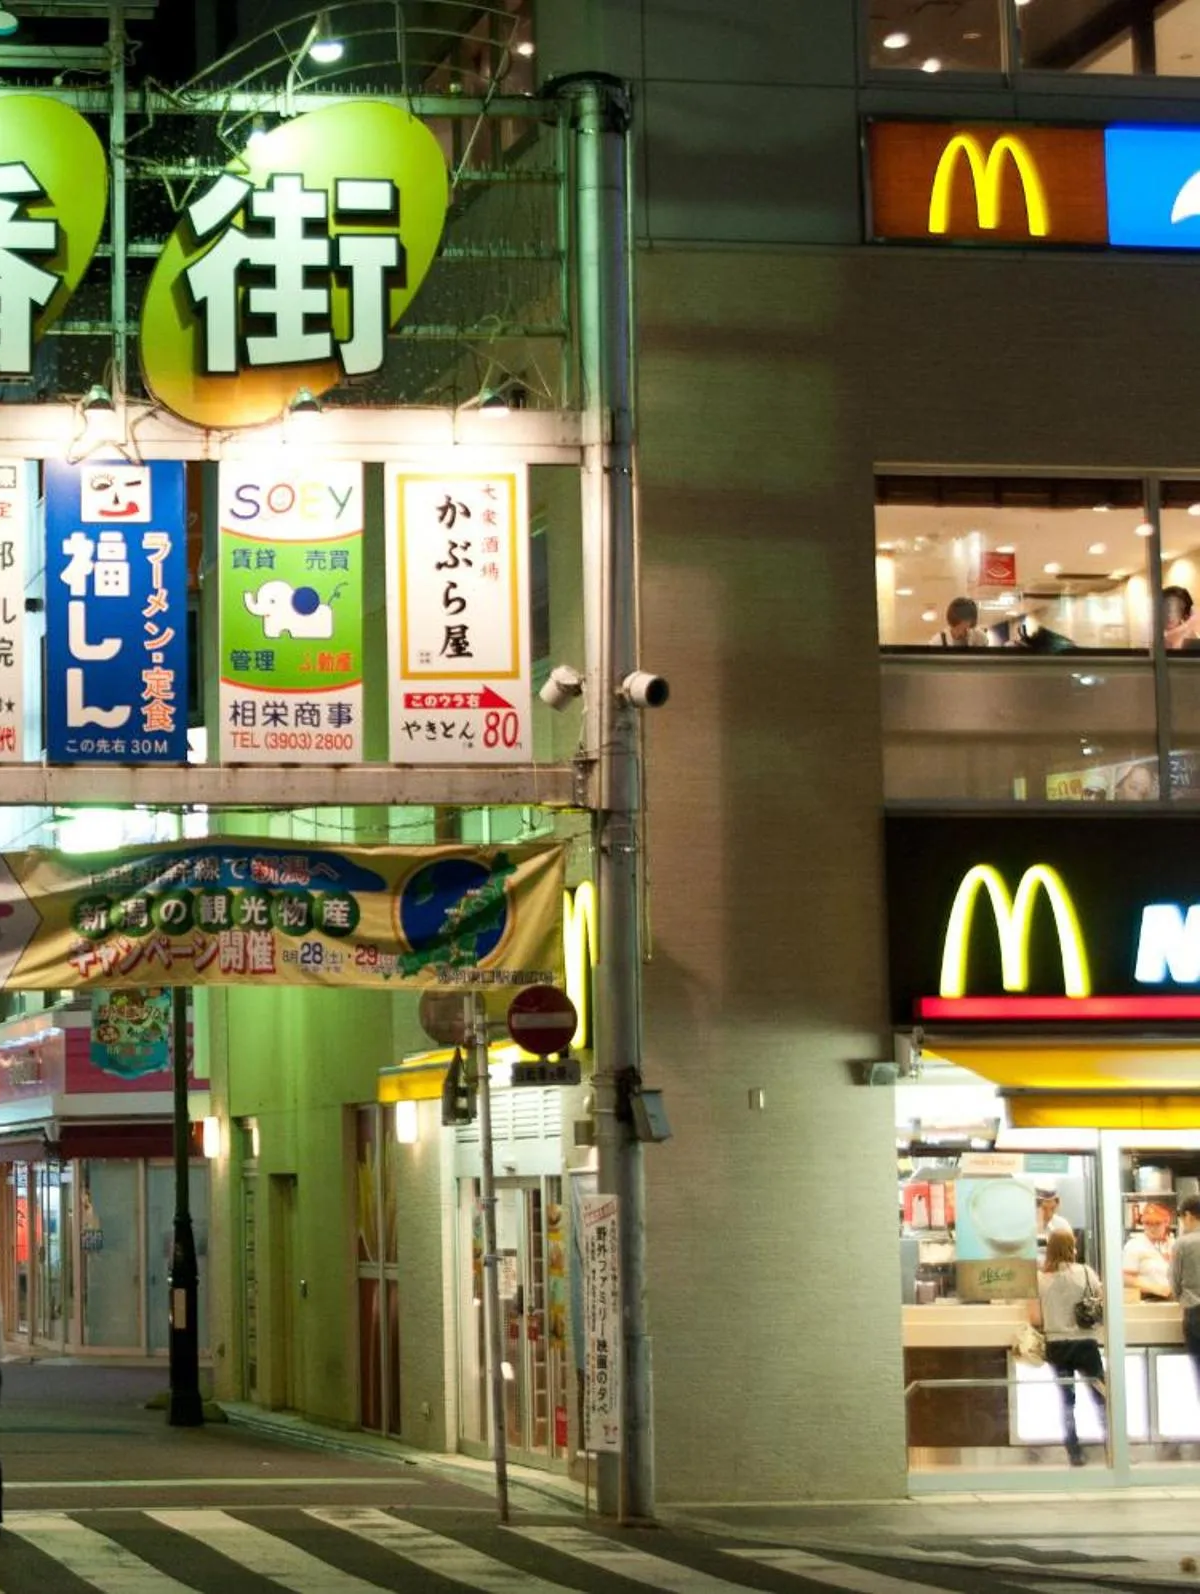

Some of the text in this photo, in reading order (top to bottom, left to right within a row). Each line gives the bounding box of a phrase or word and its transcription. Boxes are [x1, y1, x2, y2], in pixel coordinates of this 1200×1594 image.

[229, 482, 353, 520] SOEY
[231, 549, 350, 571] 賃貸 売買
[436, 494, 473, 659] かぶら屋
[60, 531, 131, 728] 福しん
[142, 531, 176, 732] ラーメン・定食
[230, 650, 275, 672] 管理
[229, 701, 353, 728] 相栄商事
[410, 693, 480, 708] このウラ右
[65, 739, 168, 754] この先右 30M
[231, 732, 260, 748] TEL
[401, 720, 475, 741] やきとん
[483, 711, 519, 749] 80
[78, 893, 351, 932] 新潟の観光物産
[69, 928, 276, 979] キャンペーン開催
